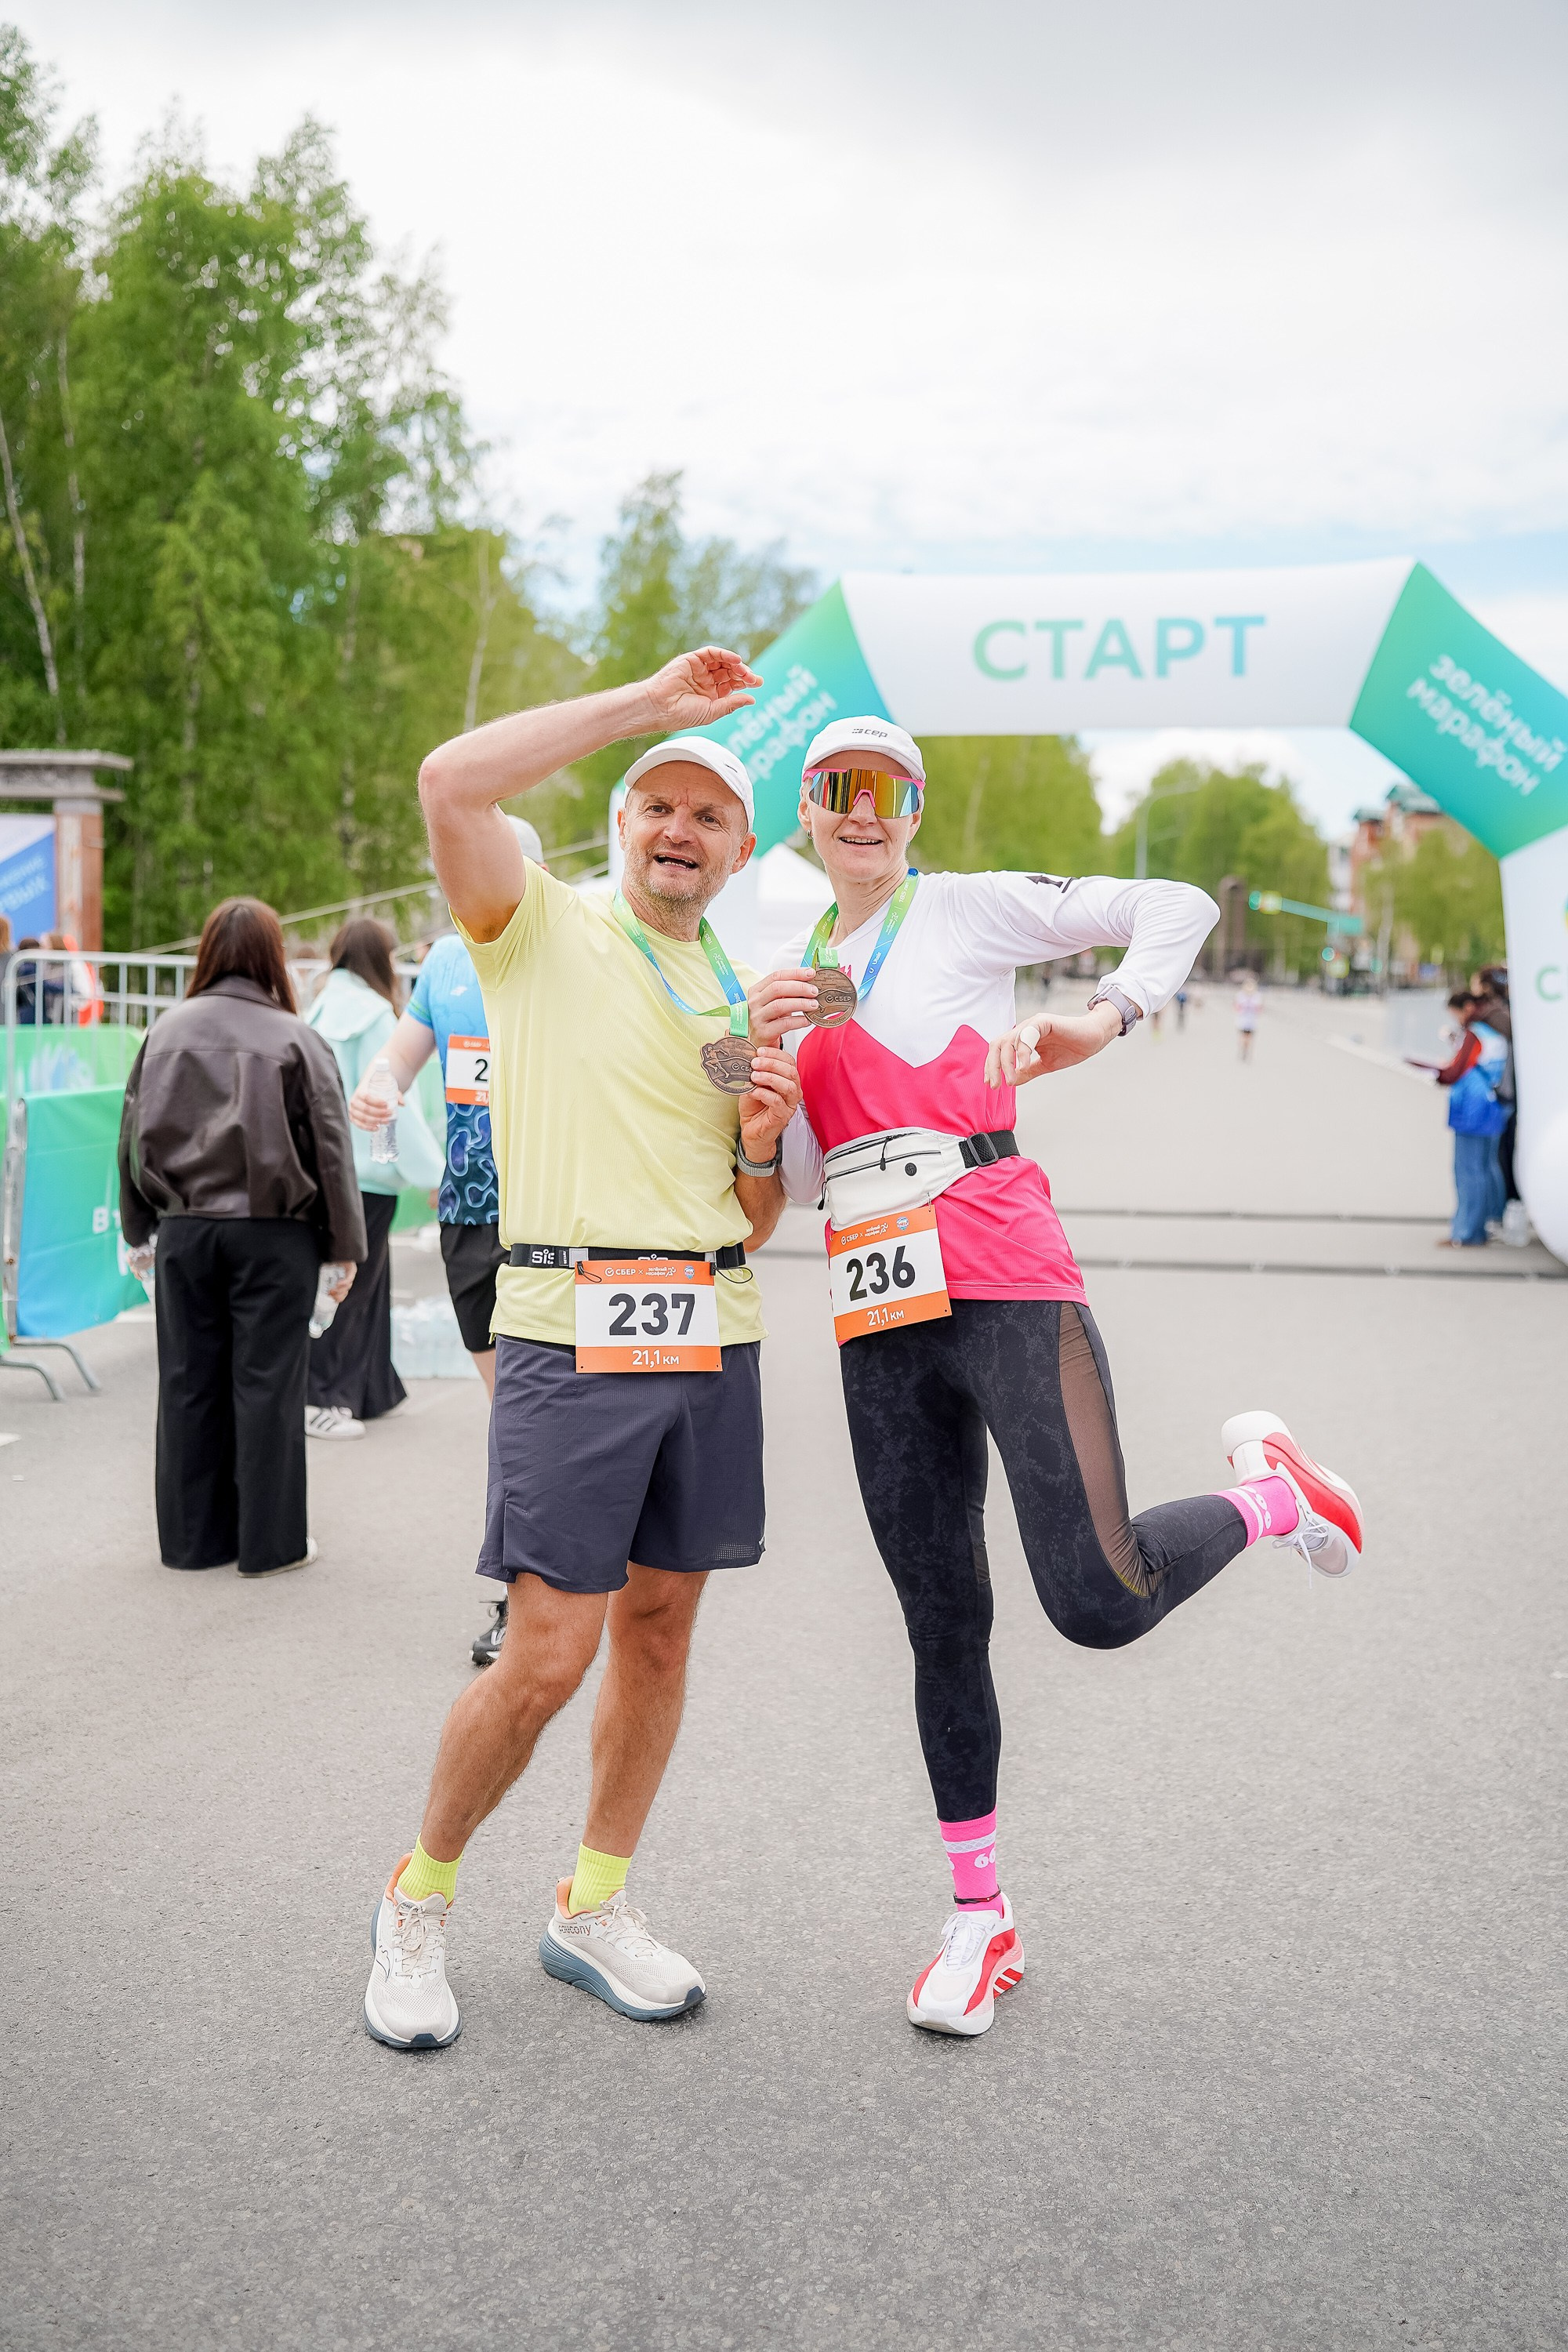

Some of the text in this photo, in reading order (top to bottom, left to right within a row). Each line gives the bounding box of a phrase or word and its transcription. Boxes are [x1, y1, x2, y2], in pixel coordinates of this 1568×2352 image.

[972, 615, 1266, 681] СТАРТ
[728, 664, 818, 757] лёный
[748, 691, 837, 784] рафон
[1406, 677, 1541, 797] марафон
[1429, 654, 1568, 773] зелёный
[475, 1058, 488, 1082] 2
[846, 1245, 916, 1301] 236
[608, 1293, 695, 1336] 237
[867, 1307, 890, 1327] 21,1
[632, 1349, 660, 1368] 21,1
